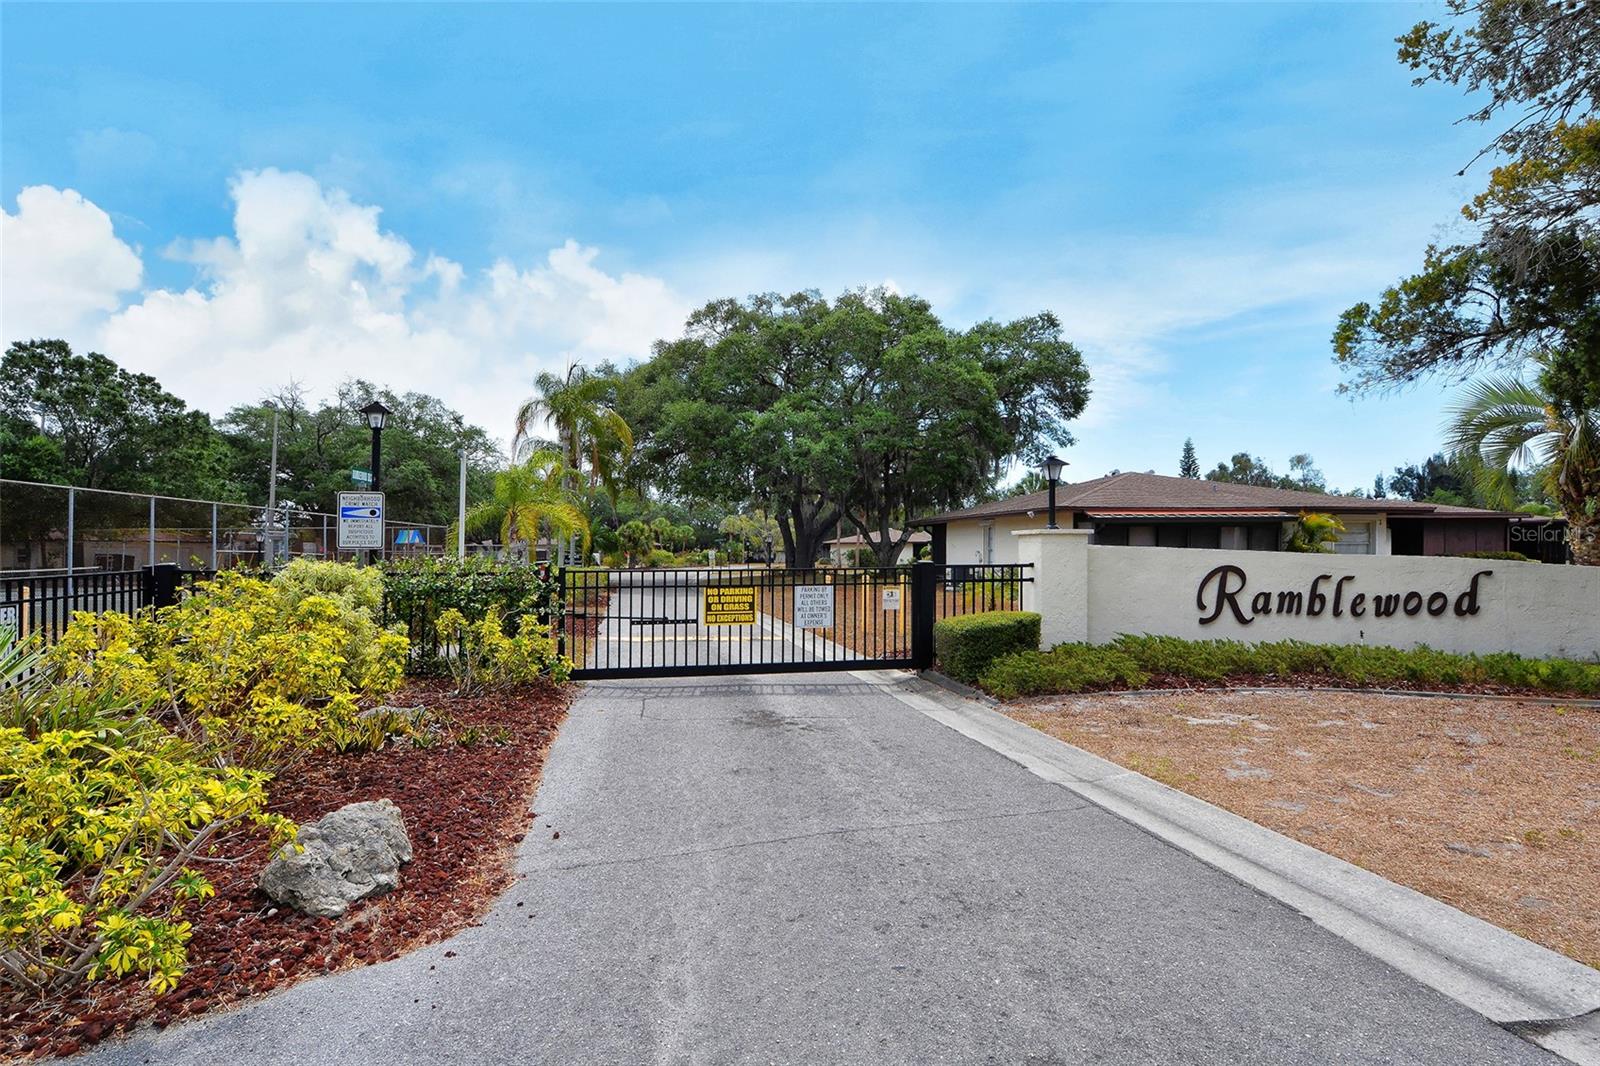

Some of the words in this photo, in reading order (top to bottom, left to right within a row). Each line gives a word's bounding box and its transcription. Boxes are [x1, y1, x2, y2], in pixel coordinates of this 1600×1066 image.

[707, 588, 718, 596] NO
[720, 587, 754, 595] PARKING
[1196, 564, 1493, 626] Ramblewood
[707, 614, 716, 622] NO
[717, 614, 754, 622] EXCEPTIONS
